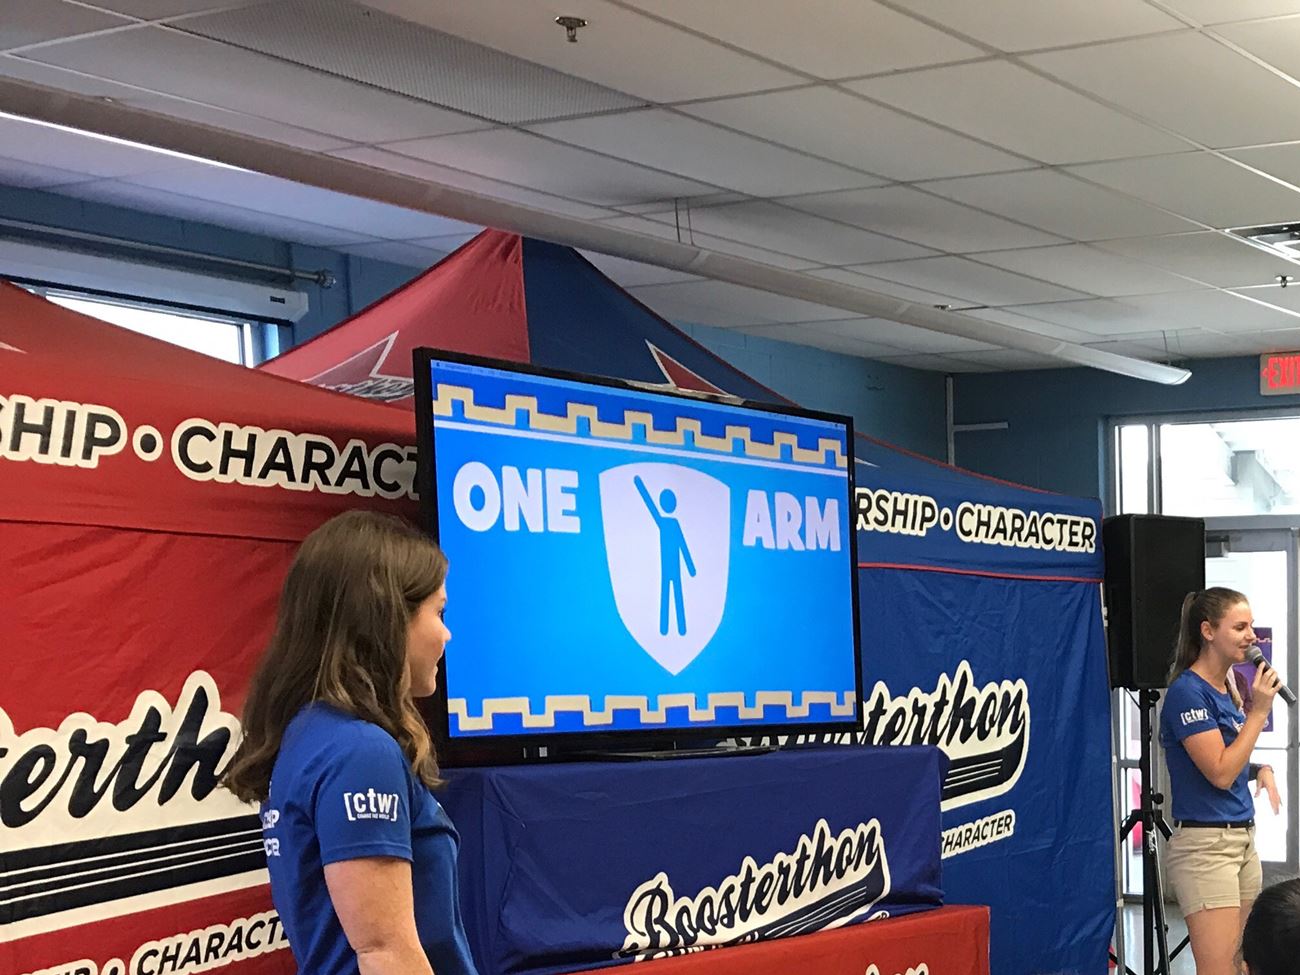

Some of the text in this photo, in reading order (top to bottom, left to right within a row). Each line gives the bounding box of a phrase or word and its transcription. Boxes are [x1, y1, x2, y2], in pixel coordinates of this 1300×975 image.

[0, 402, 122, 460] HIP
[453, 461, 841, 552] ONE ARM
[856, 492, 1096, 549] RSHIP CHARACTER
[0, 685, 234, 829] erth
[941, 814, 1013, 853] HARACTER
[619, 826, 877, 954] Boosterthon
